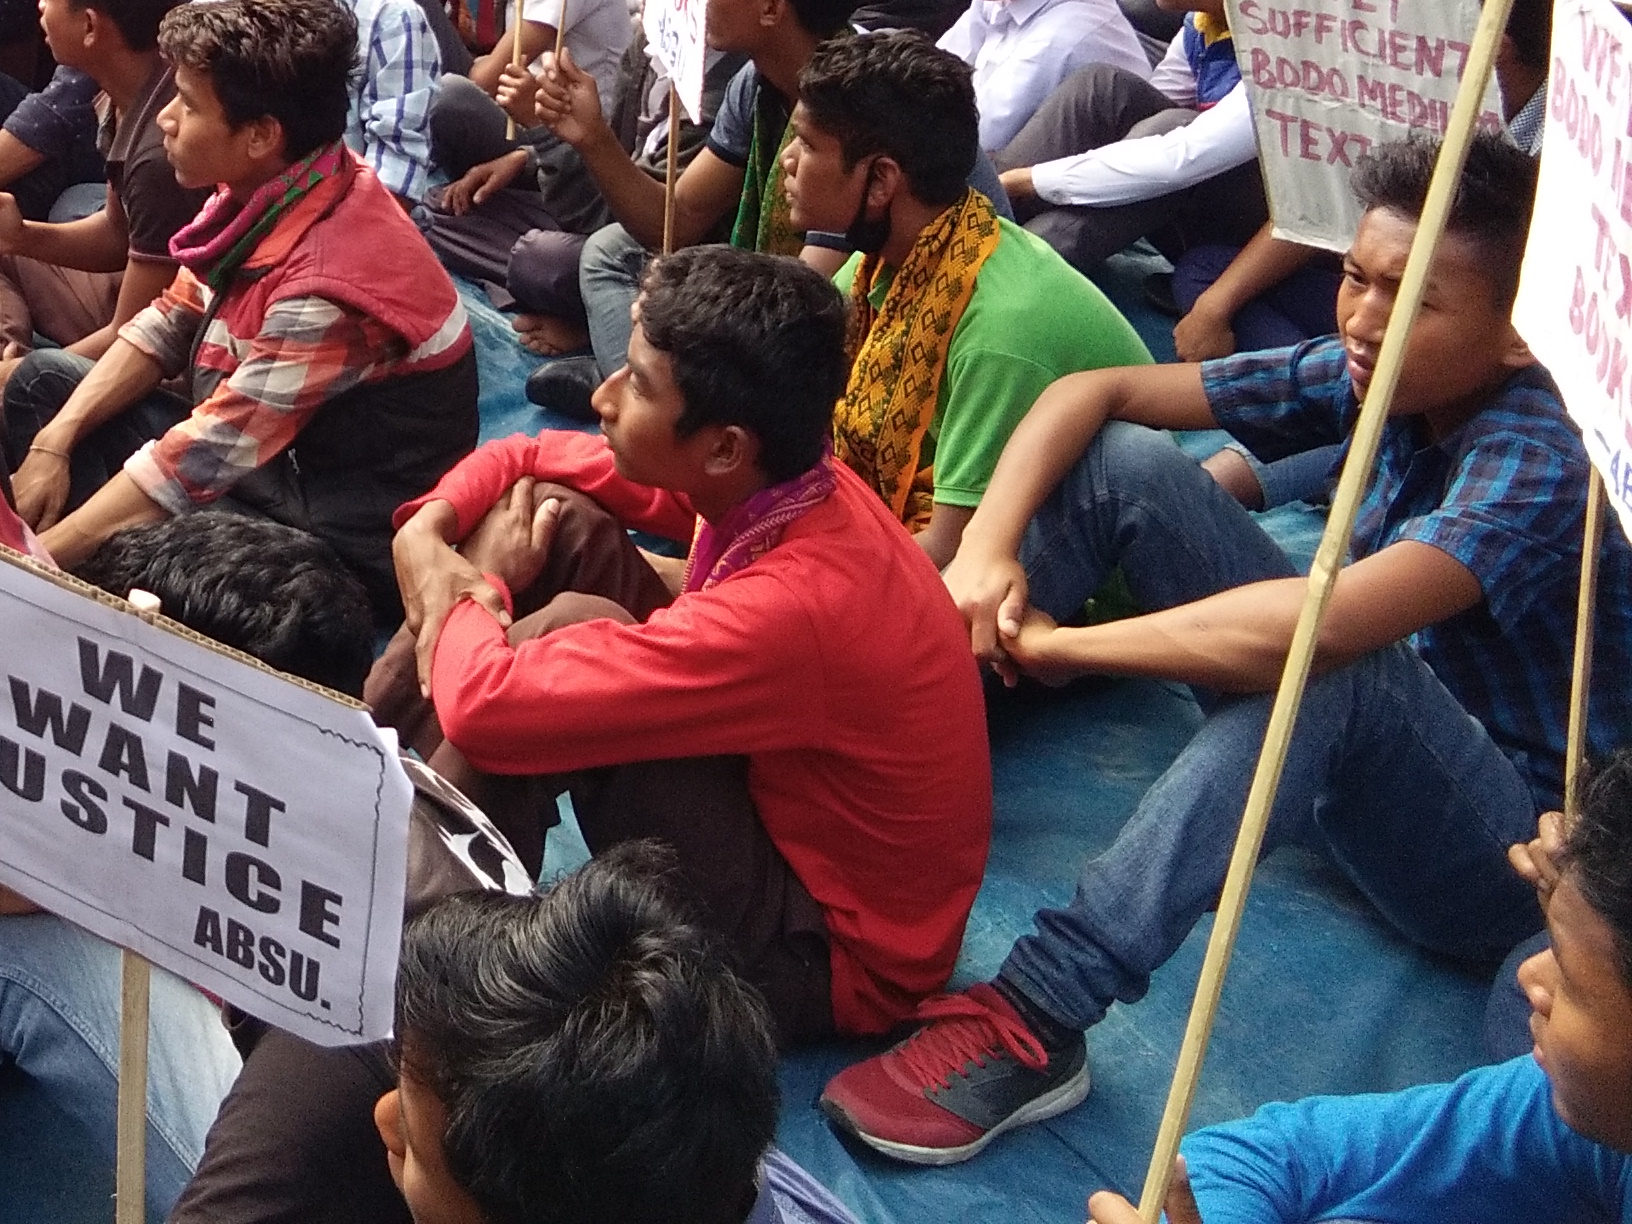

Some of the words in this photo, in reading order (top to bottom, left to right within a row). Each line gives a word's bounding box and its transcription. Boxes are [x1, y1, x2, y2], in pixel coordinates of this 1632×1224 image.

[1239, 0, 1471, 79] SUFFICIENT
[1251, 48, 1349, 98] BODO
[77, 636, 218, 752] WE
[7, 675, 286, 848] WANT
[193, 906, 332, 1011] ABSU.
